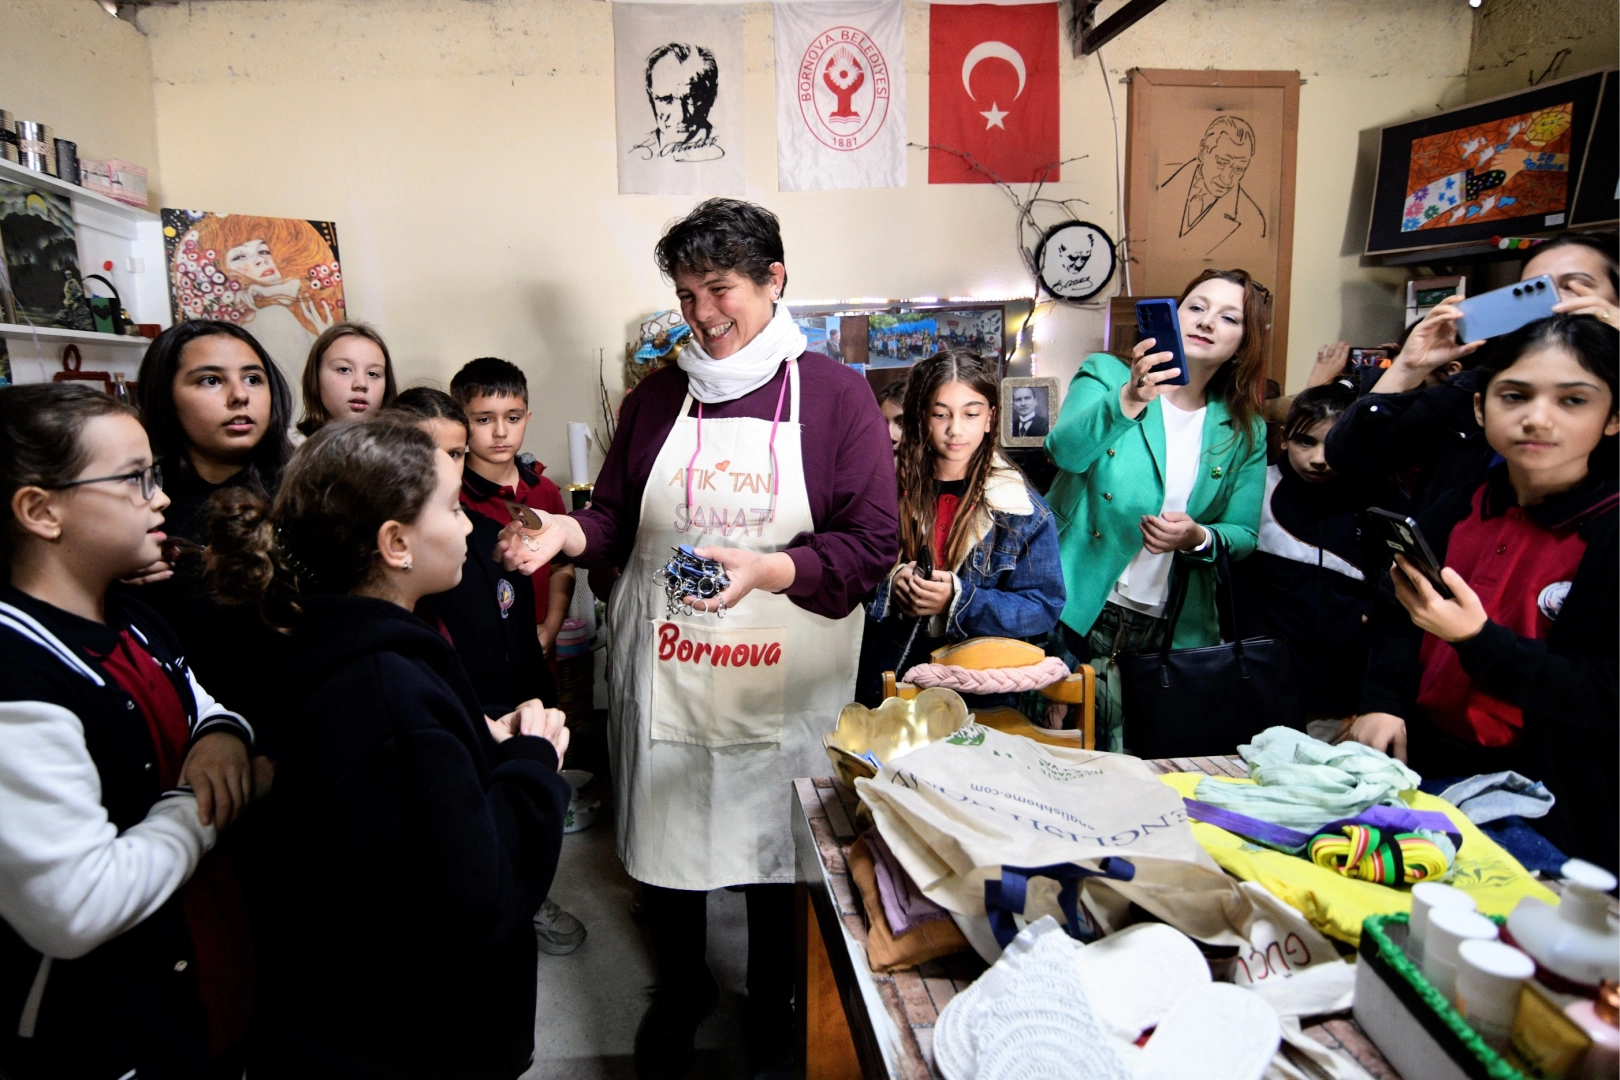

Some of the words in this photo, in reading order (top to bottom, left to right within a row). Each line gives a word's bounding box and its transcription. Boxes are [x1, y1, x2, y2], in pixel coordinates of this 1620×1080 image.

[800, 34, 835, 101] BORNOVA
[832, 136, 857, 148] 1881
[668, 467, 716, 491] ATIK
[728, 472, 772, 493] TAN
[674, 503, 774, 537] SANAT
[658, 622, 782, 668] Bornova
[970, 783, 1095, 831] englishhome.com
